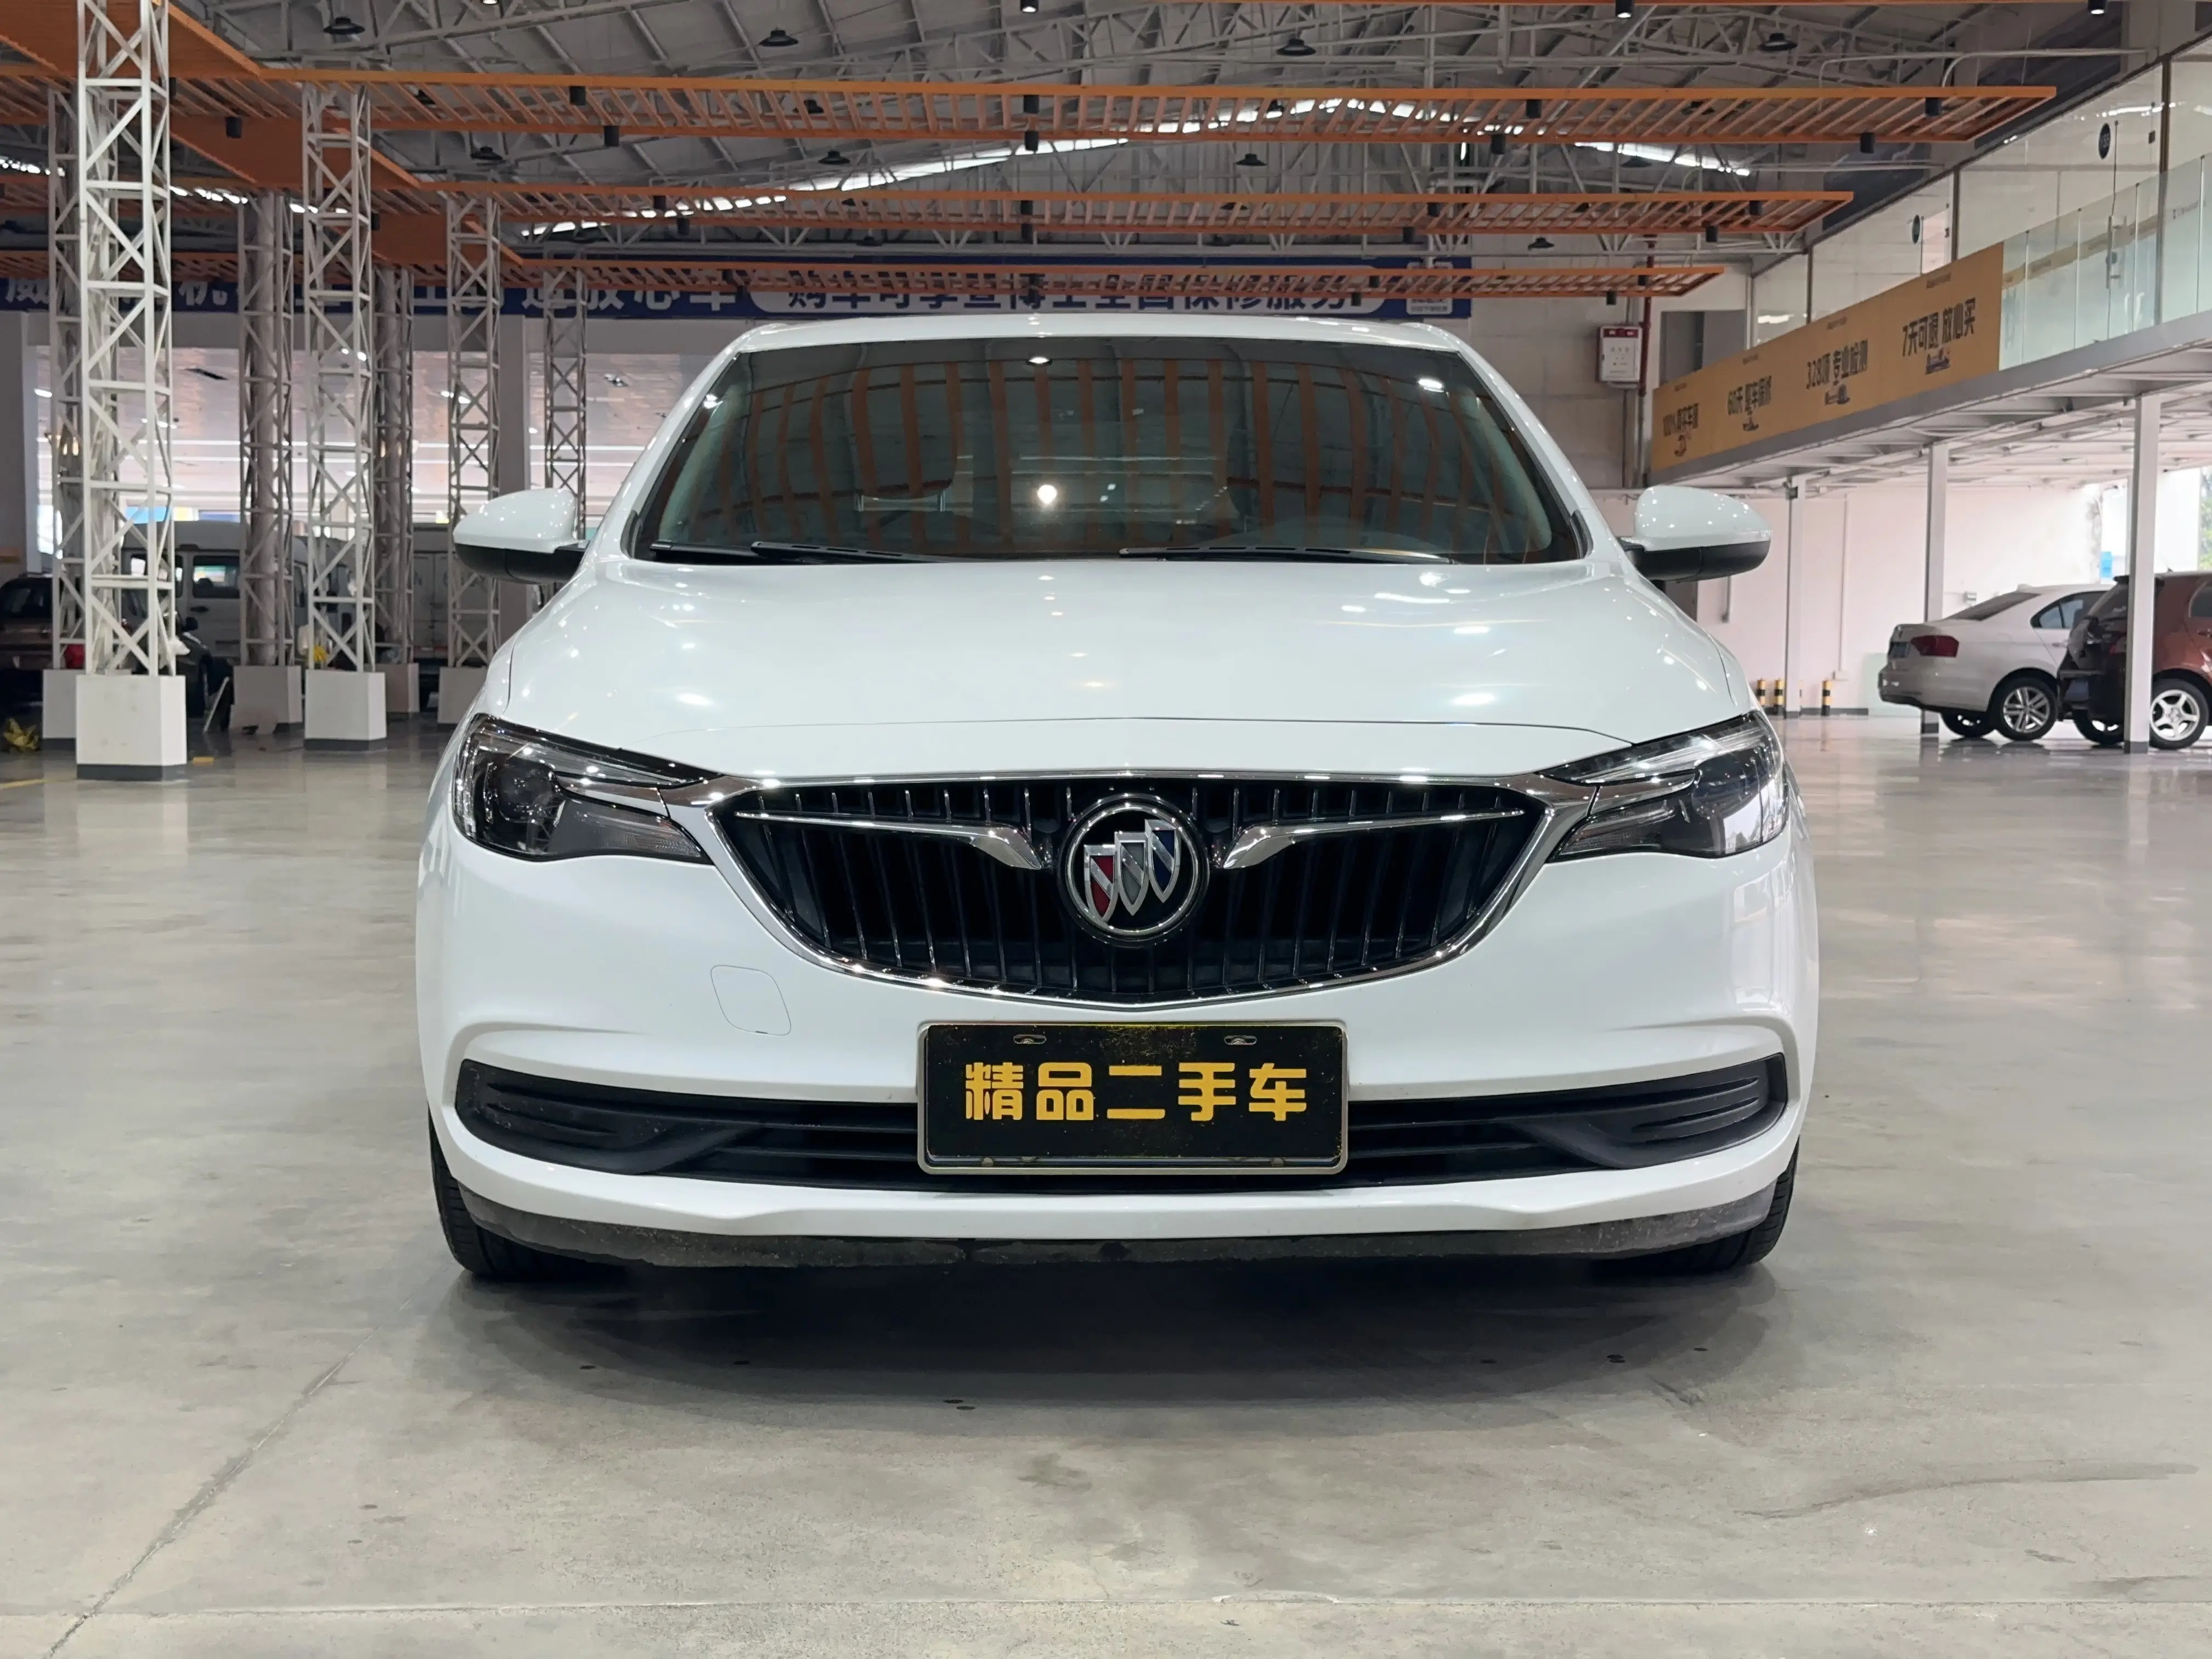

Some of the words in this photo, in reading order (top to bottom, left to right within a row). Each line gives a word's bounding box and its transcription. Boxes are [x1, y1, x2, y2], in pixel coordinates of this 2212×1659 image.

[965, 1061, 1307, 1121] 精品二手车
